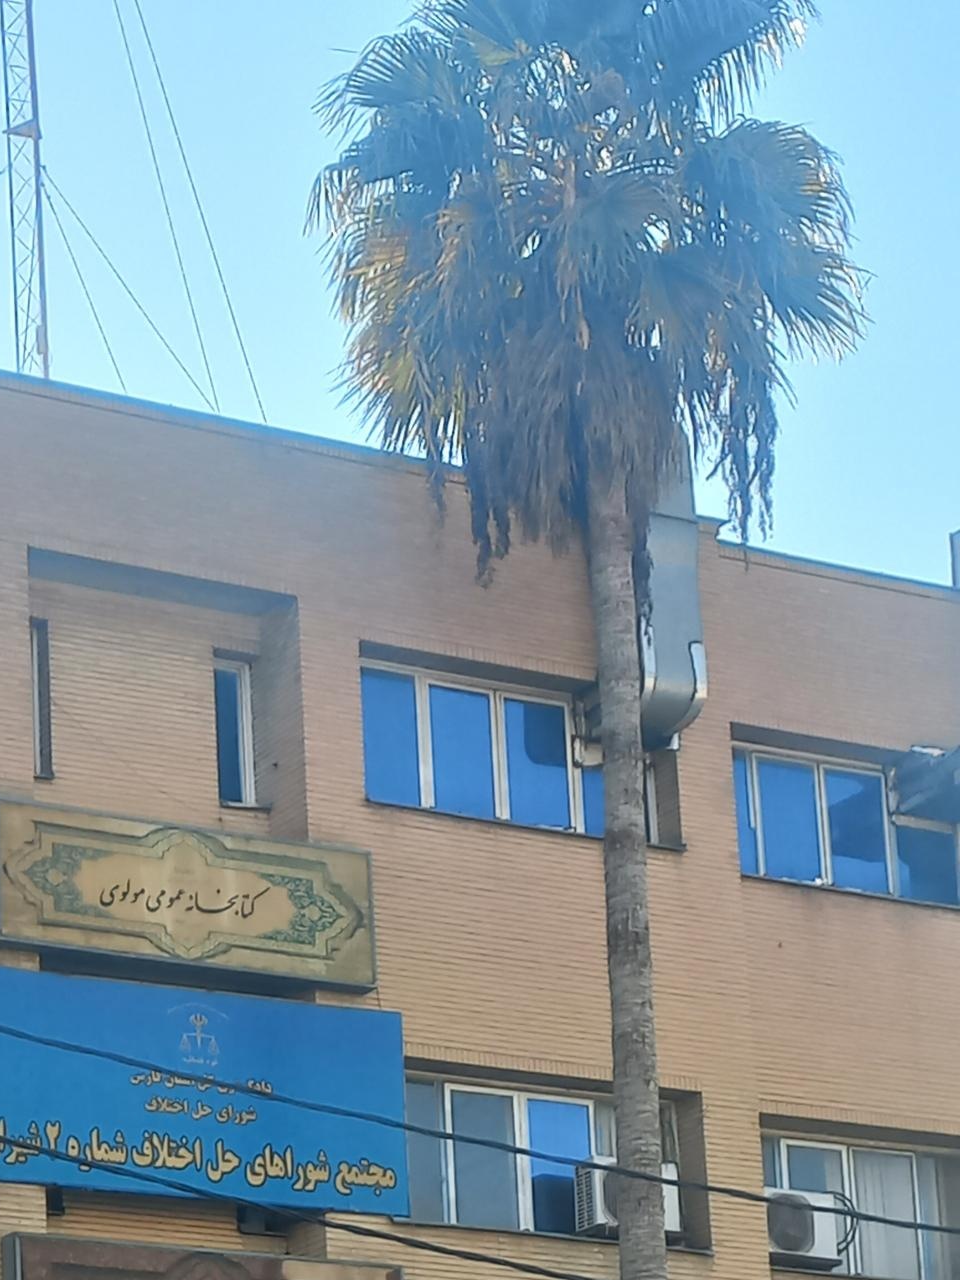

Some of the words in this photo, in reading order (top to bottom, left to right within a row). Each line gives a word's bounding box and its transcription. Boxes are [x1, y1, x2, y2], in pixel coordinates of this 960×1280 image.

[99, 878, 145, 907] مولوی
[146, 888, 185, 912] عمومی
[144, 1096, 189, 1114] اختلاف
[191, 1101, 213, 1120] حل
[215, 1104, 258, 1125] شورای
[64, 1125, 129, 1172] شماره
[130, 1130, 204, 1172] اختلاف
[205, 1137, 242, 1184] حل
[334, 1156, 397, 1196] مجتمع
